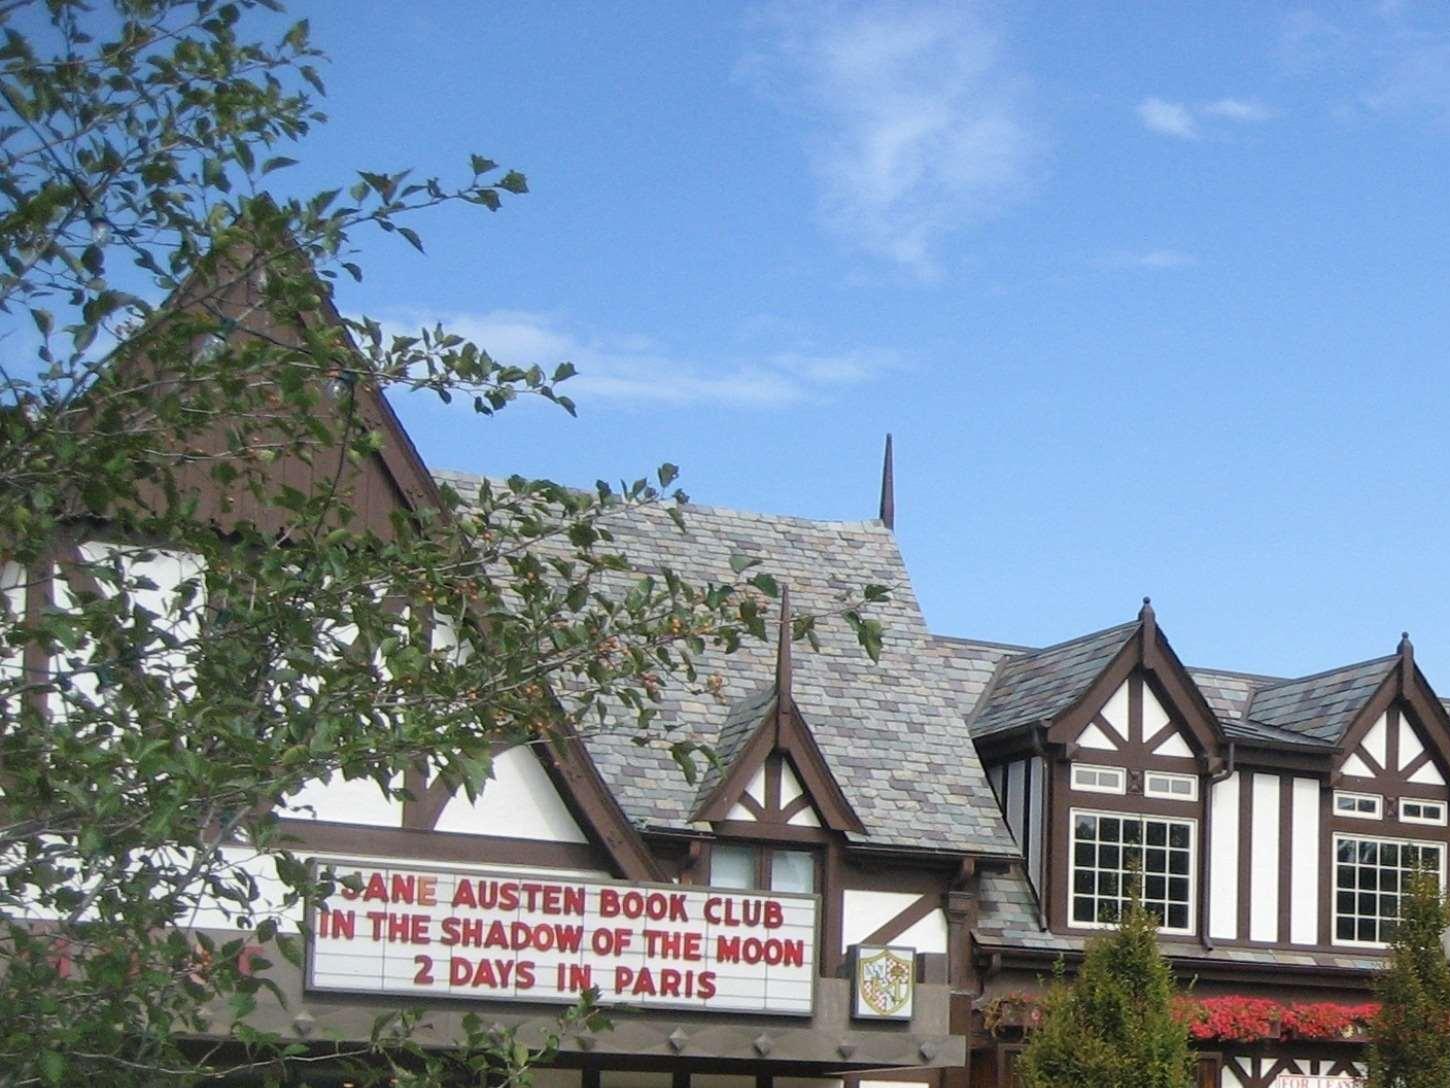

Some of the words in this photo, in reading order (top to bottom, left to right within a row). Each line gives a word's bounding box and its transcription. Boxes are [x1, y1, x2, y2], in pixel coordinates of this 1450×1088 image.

[451, 878, 585, 916] AUSTEN
[599, 888, 689, 923] BOOK
[703, 897, 785, 929] CLUB
[319, 909, 356, 940] IN
[366, 911, 432, 945] THE
[440, 917, 584, 954] SHADOW
[592, 927, 633, 957] OF
[643, 929, 702, 962] THE
[717, 936, 805, 968] MOON
[413, 956, 435, 985] 2
[449, 956, 537, 990] DAYS
[557, 963, 592, 992] IN
[615, 966, 717, 999] PARIS
